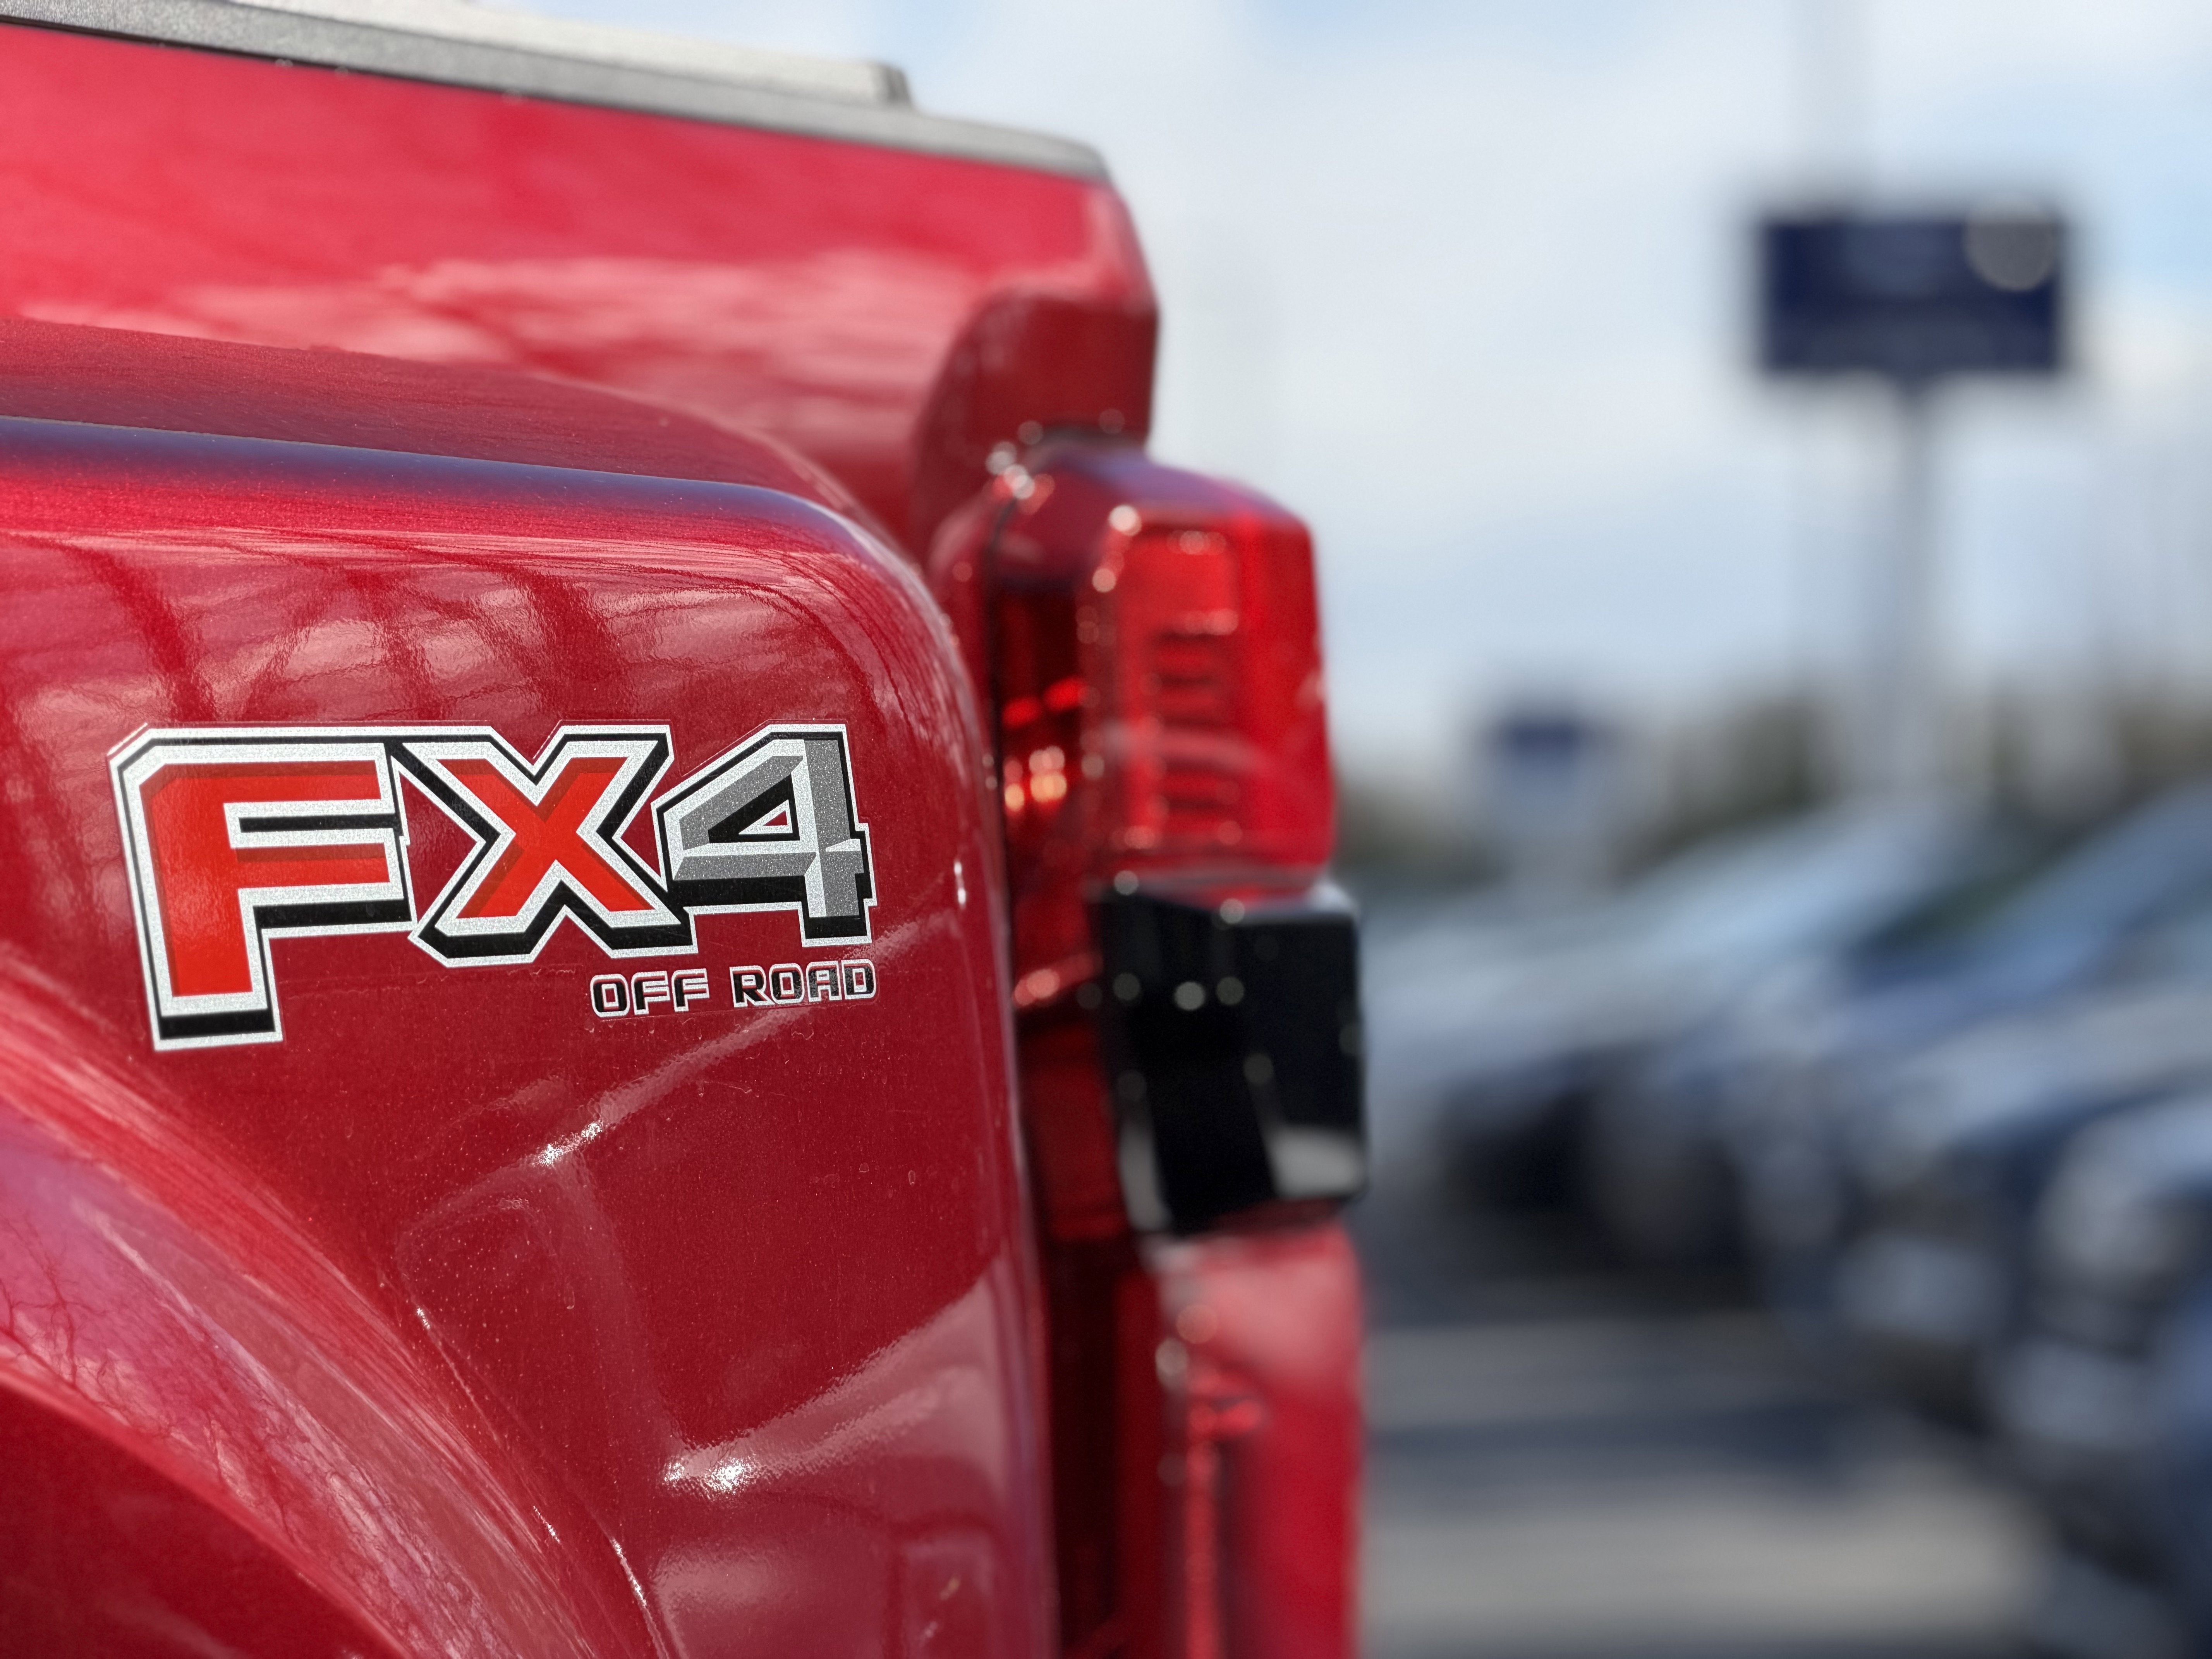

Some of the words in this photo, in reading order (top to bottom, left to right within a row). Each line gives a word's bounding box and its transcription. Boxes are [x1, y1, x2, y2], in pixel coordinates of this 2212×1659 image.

[107, 723, 877, 1051] FX4
[590, 969, 709, 1017] OFF
[730, 959, 876, 1007] ROAD
